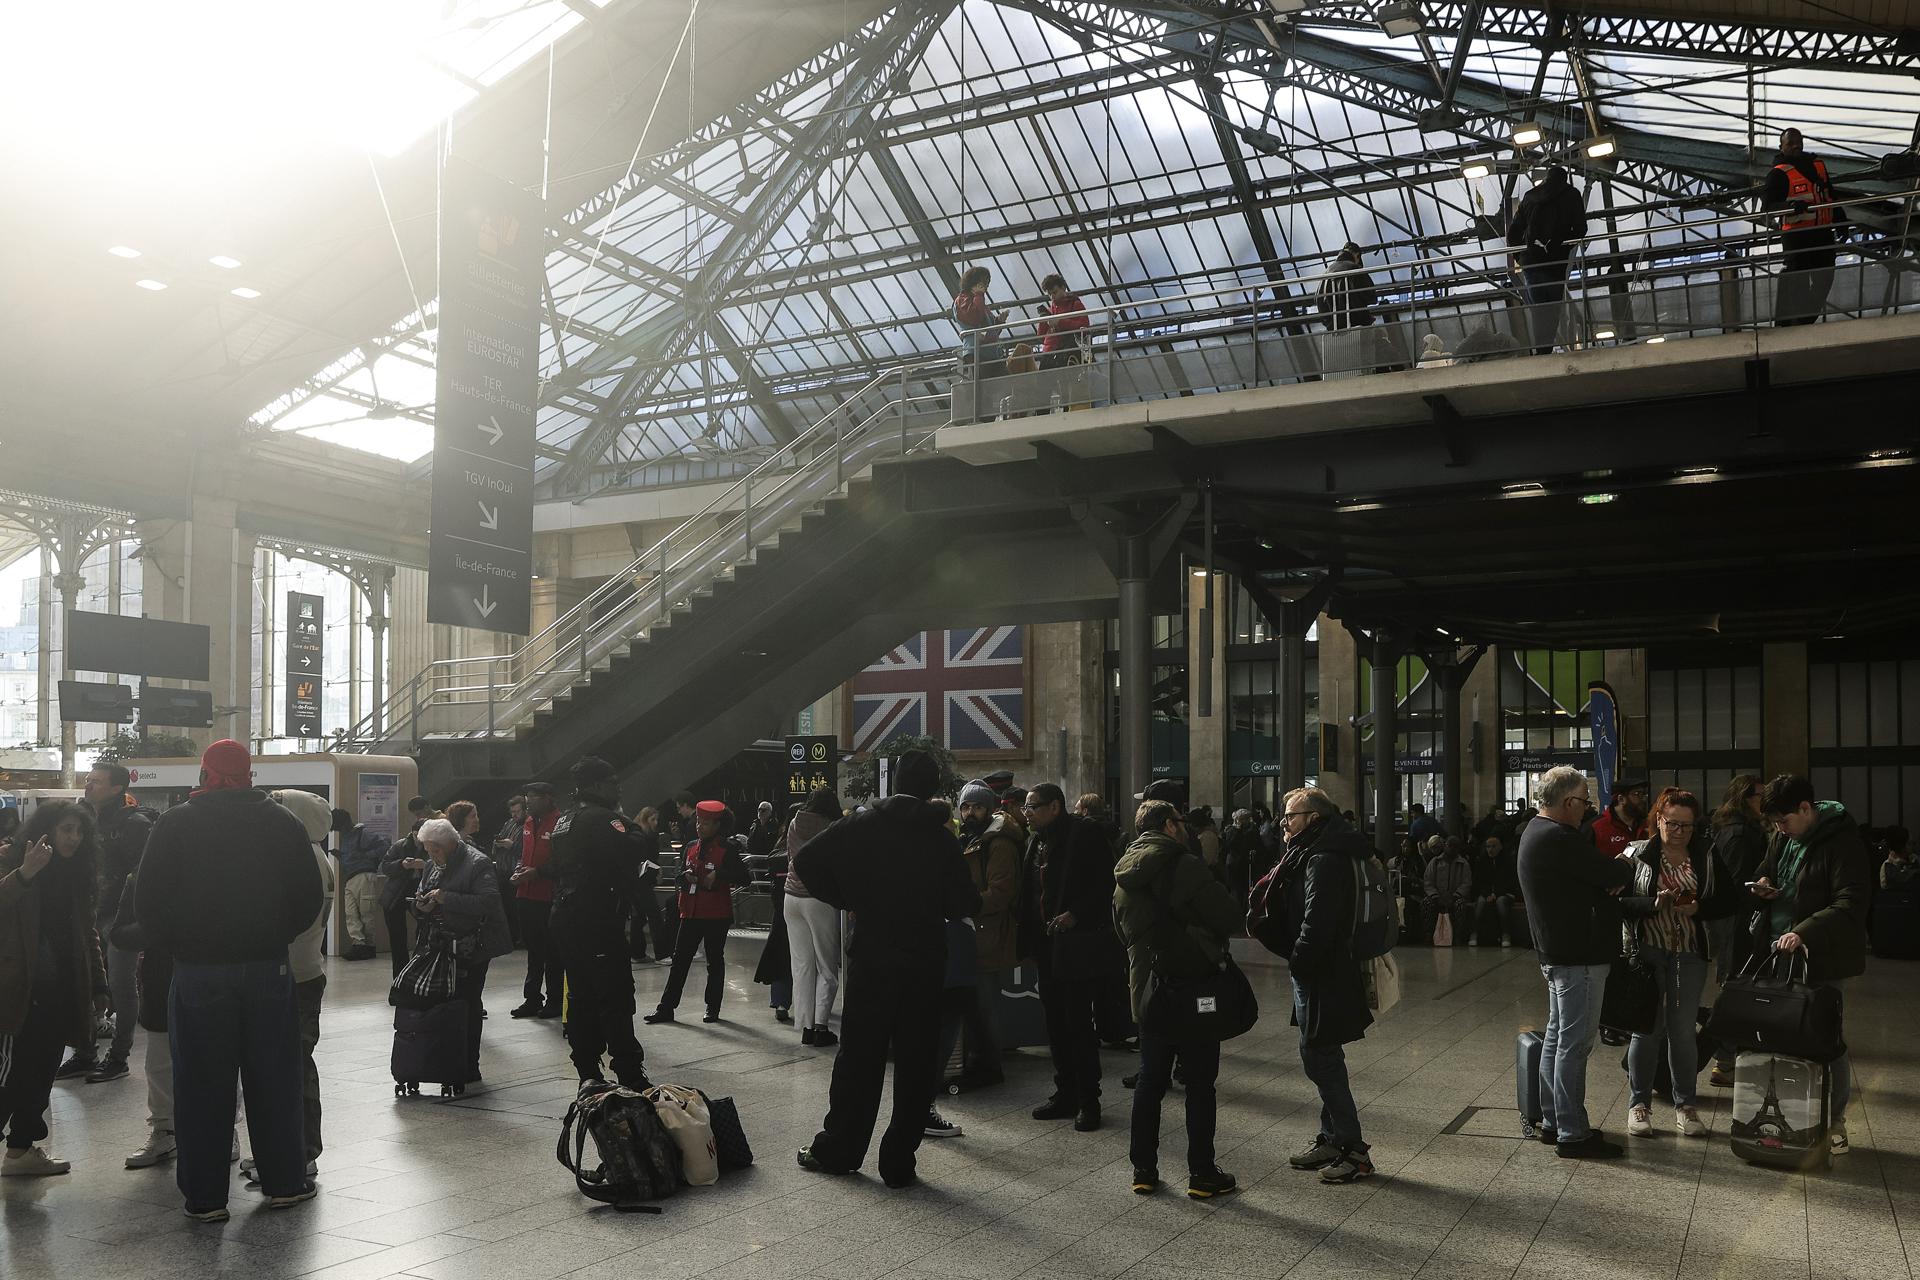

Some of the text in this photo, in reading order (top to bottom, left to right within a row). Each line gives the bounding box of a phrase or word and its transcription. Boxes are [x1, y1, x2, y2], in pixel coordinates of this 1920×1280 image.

[463, 323, 525, 359] International
[467, 341, 520, 369] EUROSTAR
[451, 375, 531, 415] Hauts-de-France
[483, 375, 502, 391] TER
[464, 470, 513, 494] TGV InOui
[455, 554, 517, 579] Île-de-France
[139, 771, 157, 780] selecta
